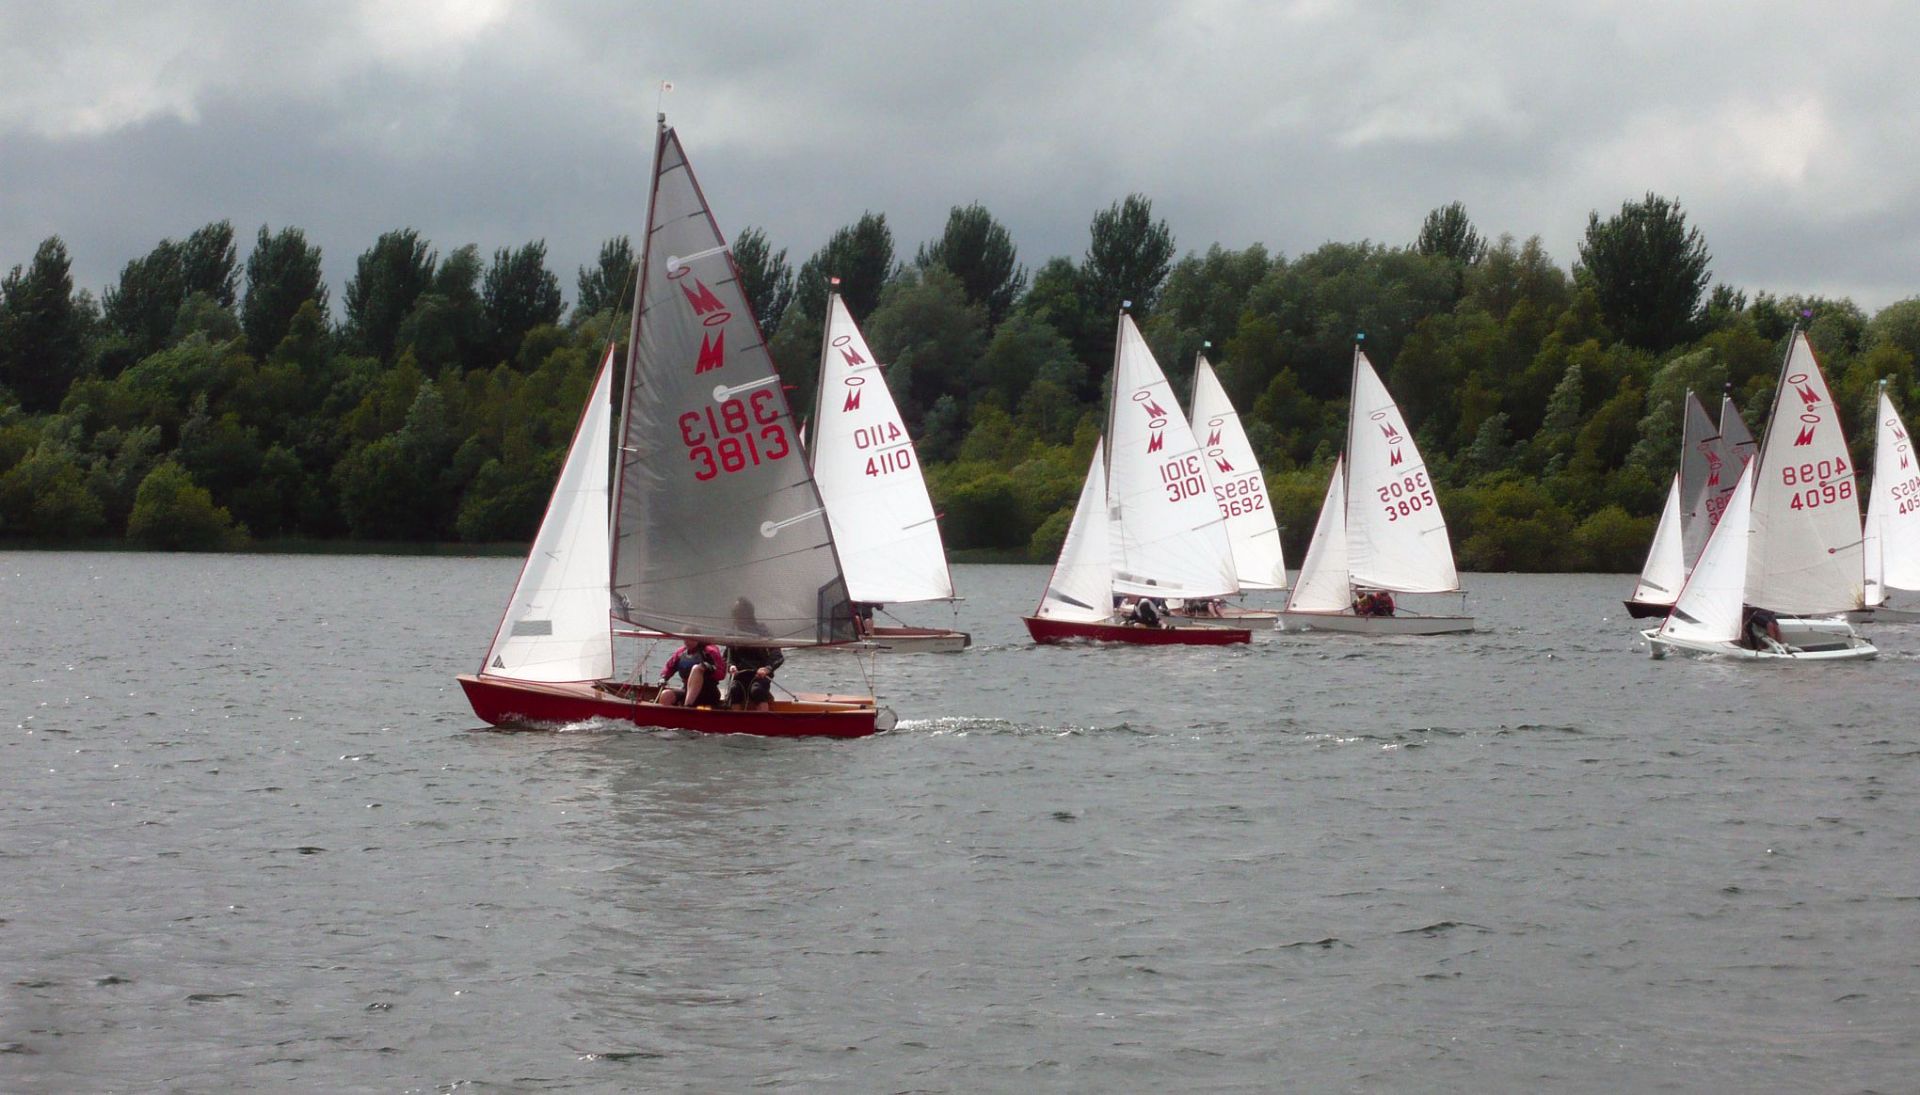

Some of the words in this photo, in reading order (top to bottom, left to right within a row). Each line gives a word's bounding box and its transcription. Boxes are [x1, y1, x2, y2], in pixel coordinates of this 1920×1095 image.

[689, 425, 790, 481] 3813
[866, 449, 911, 477] 4110
[1166, 475, 1206, 502] 3101
[1790, 481, 1852, 511] 4098
[1219, 494, 1265, 520] 3692
[1385, 490, 1433, 521] 3805
[1899, 495, 1920, 515] 405
